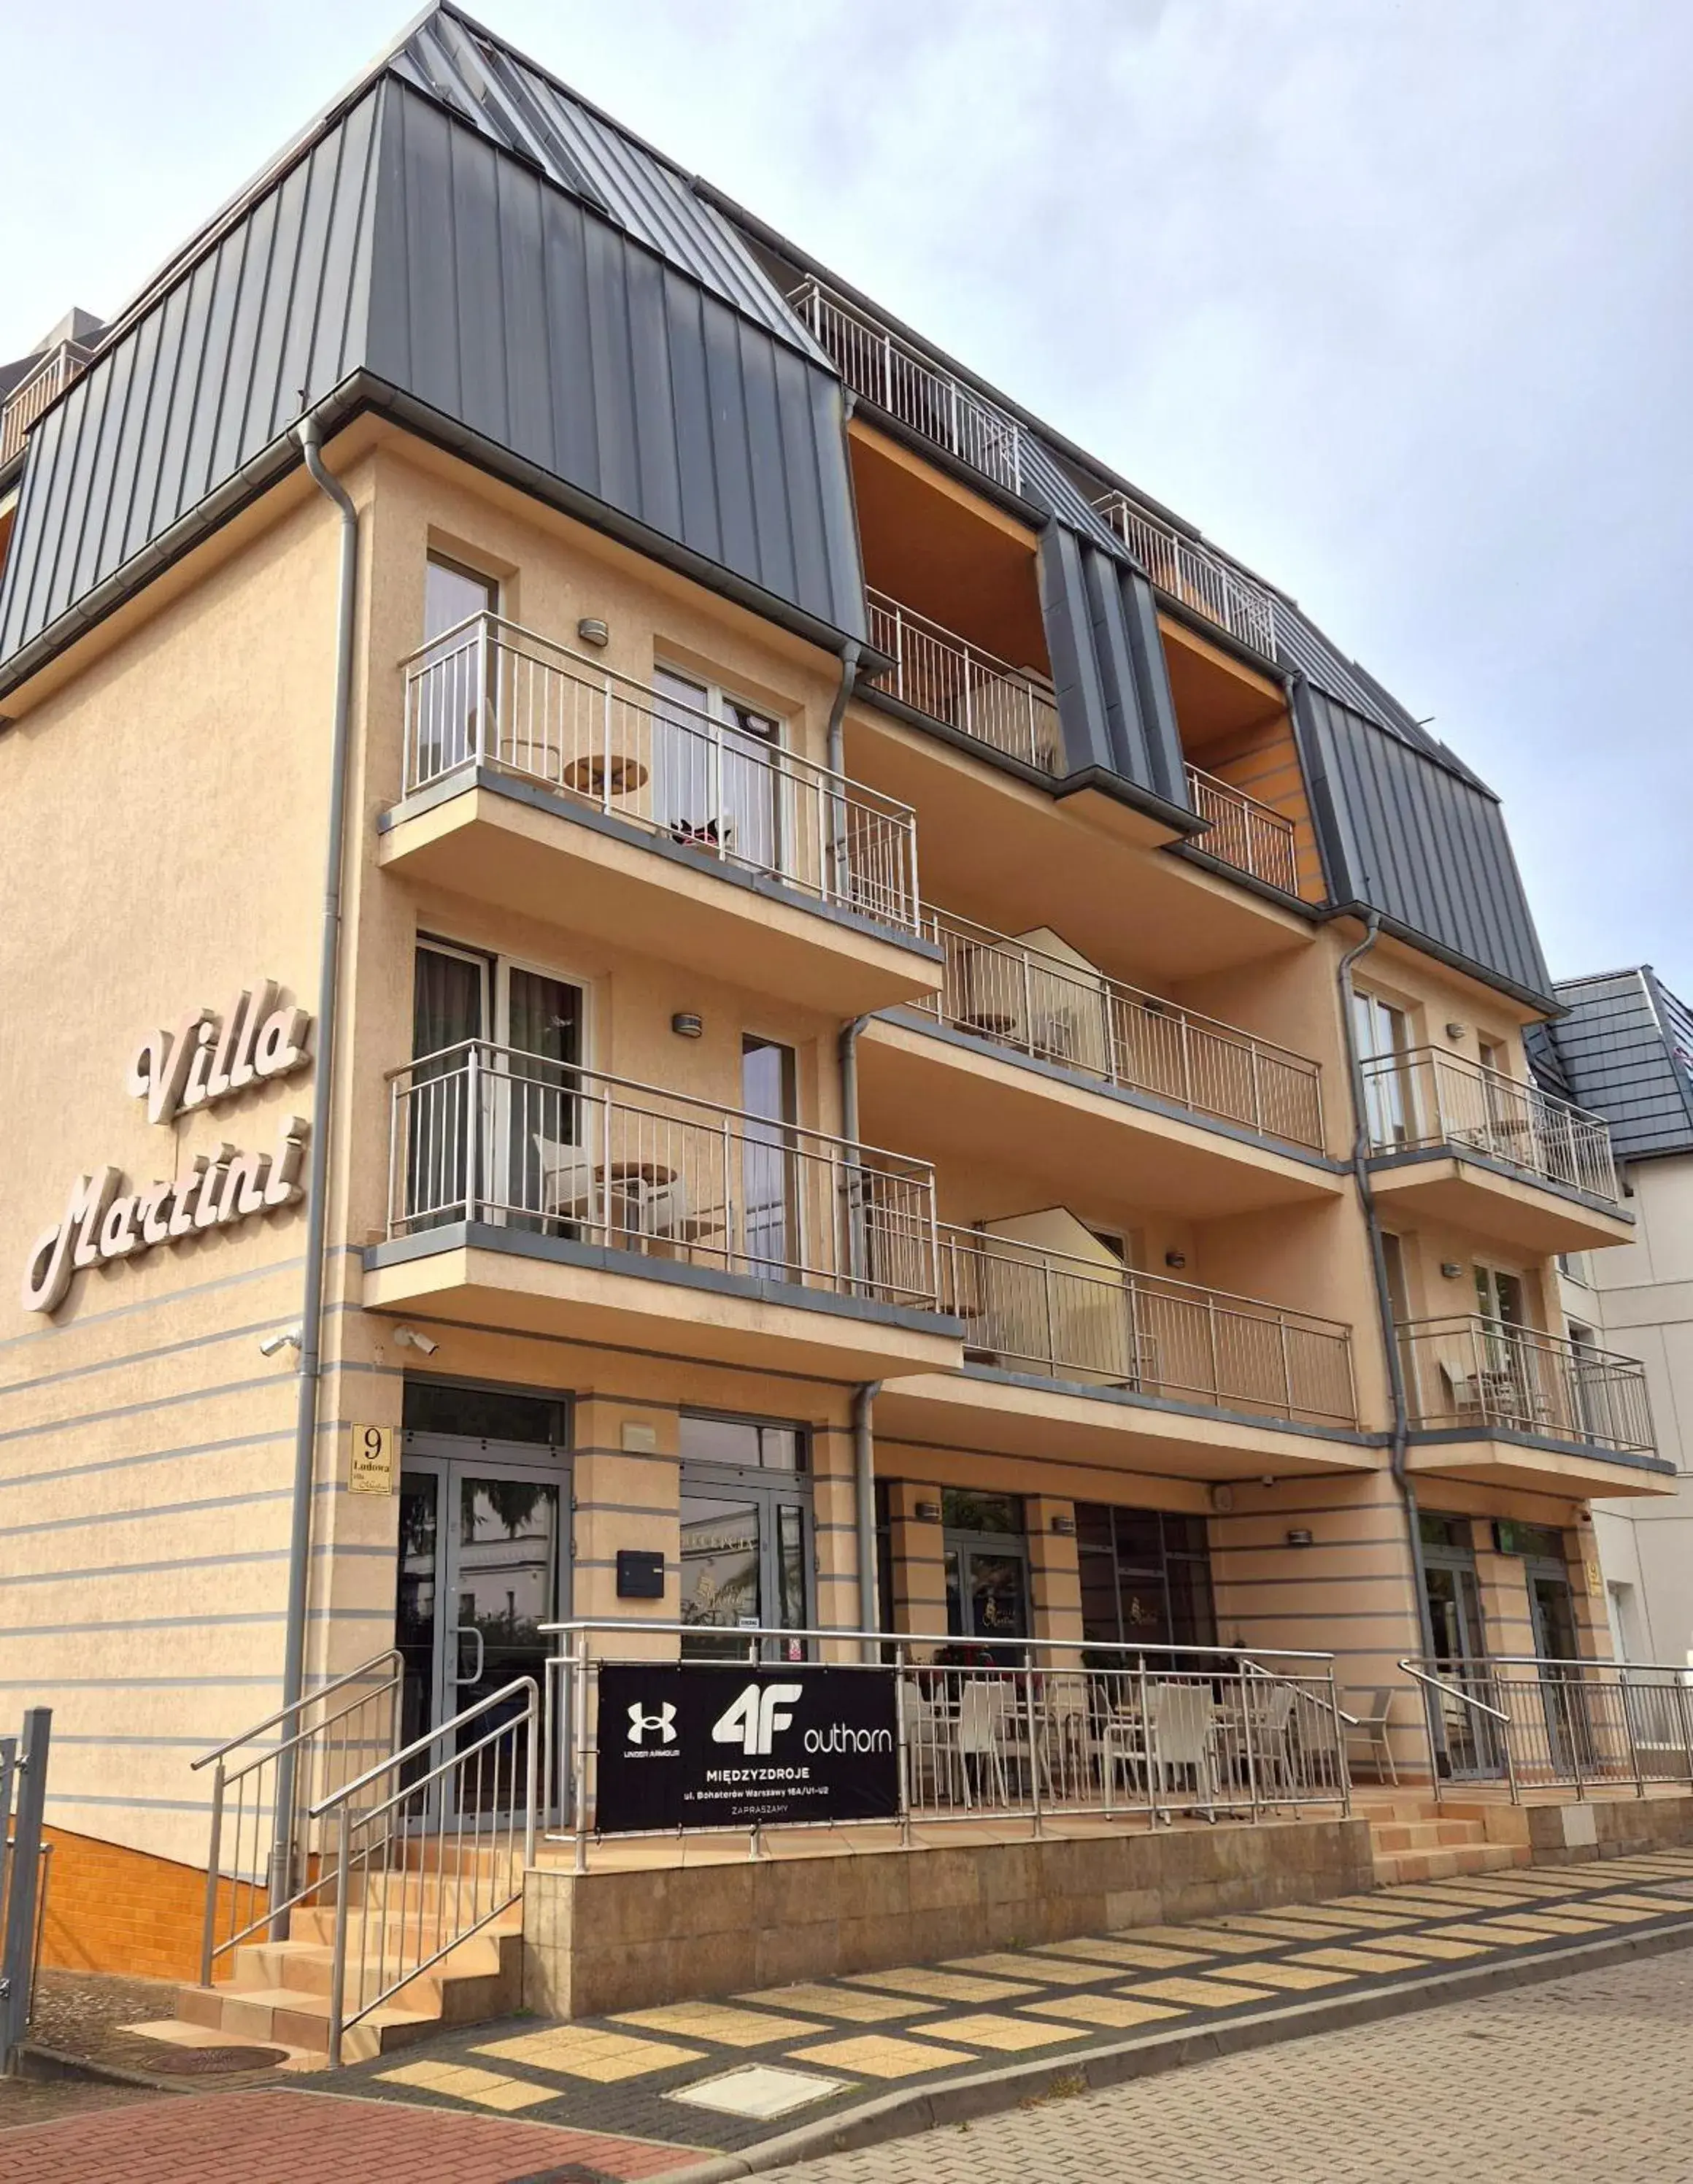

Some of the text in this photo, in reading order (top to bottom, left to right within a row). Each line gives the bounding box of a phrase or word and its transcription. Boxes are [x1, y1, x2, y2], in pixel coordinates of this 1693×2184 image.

[127, 979, 315, 1125] Villa
[23, 1116, 310, 1312] Martini
[364, 1427, 382, 1460] 9
[353, 1460, 390, 1473] Ludowa
[711, 1684, 803, 1756] 4F
[804, 1722, 892, 1754] outhorn
[706, 1767, 811, 1785] MIĘDZYZDROJE
[697, 1789, 744, 1800] Bohaterów
[745, 1788, 786, 1798] Warszawy
[731, 1804, 789, 1815] ZAPRASZAMY
